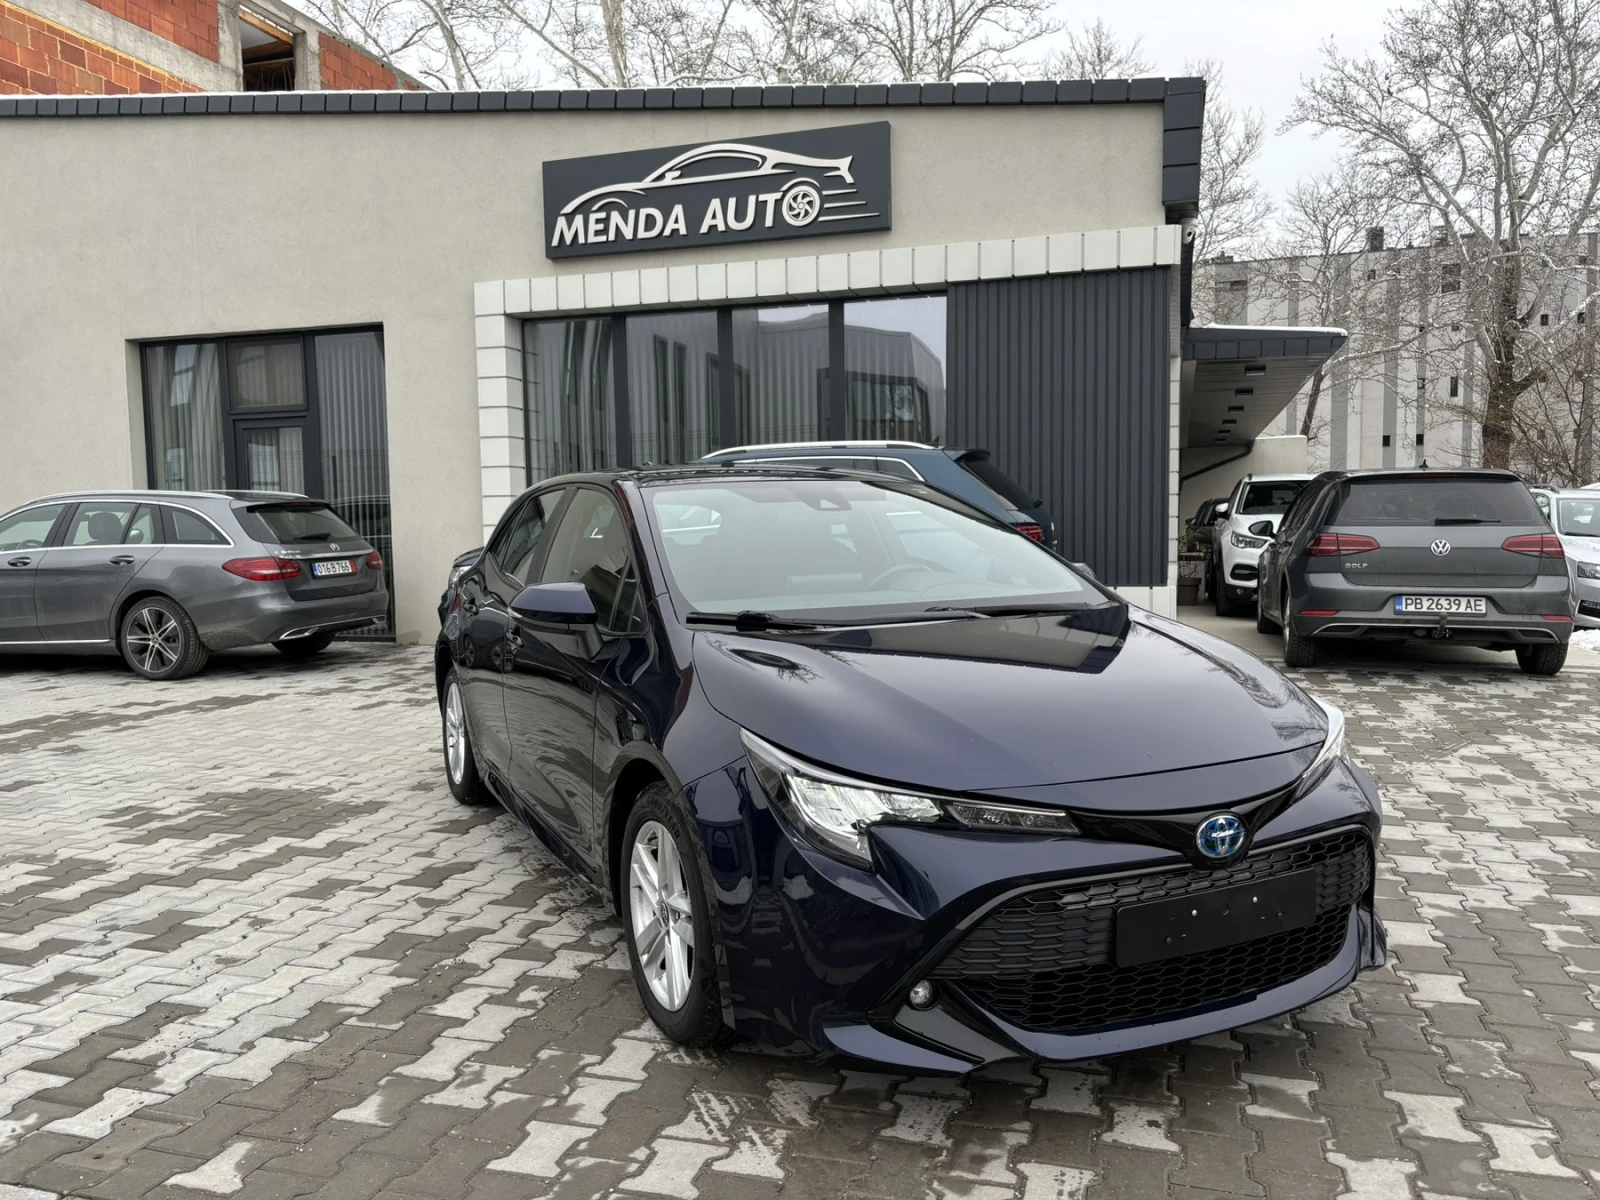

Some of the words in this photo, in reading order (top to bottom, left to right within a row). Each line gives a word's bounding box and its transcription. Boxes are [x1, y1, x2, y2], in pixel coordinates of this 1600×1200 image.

[551, 204, 688, 247] MENDA
[1404, 597, 1424, 610] PB
[1426, 597, 1462, 611] 2639
[1465, 598, 1484, 612] AE
